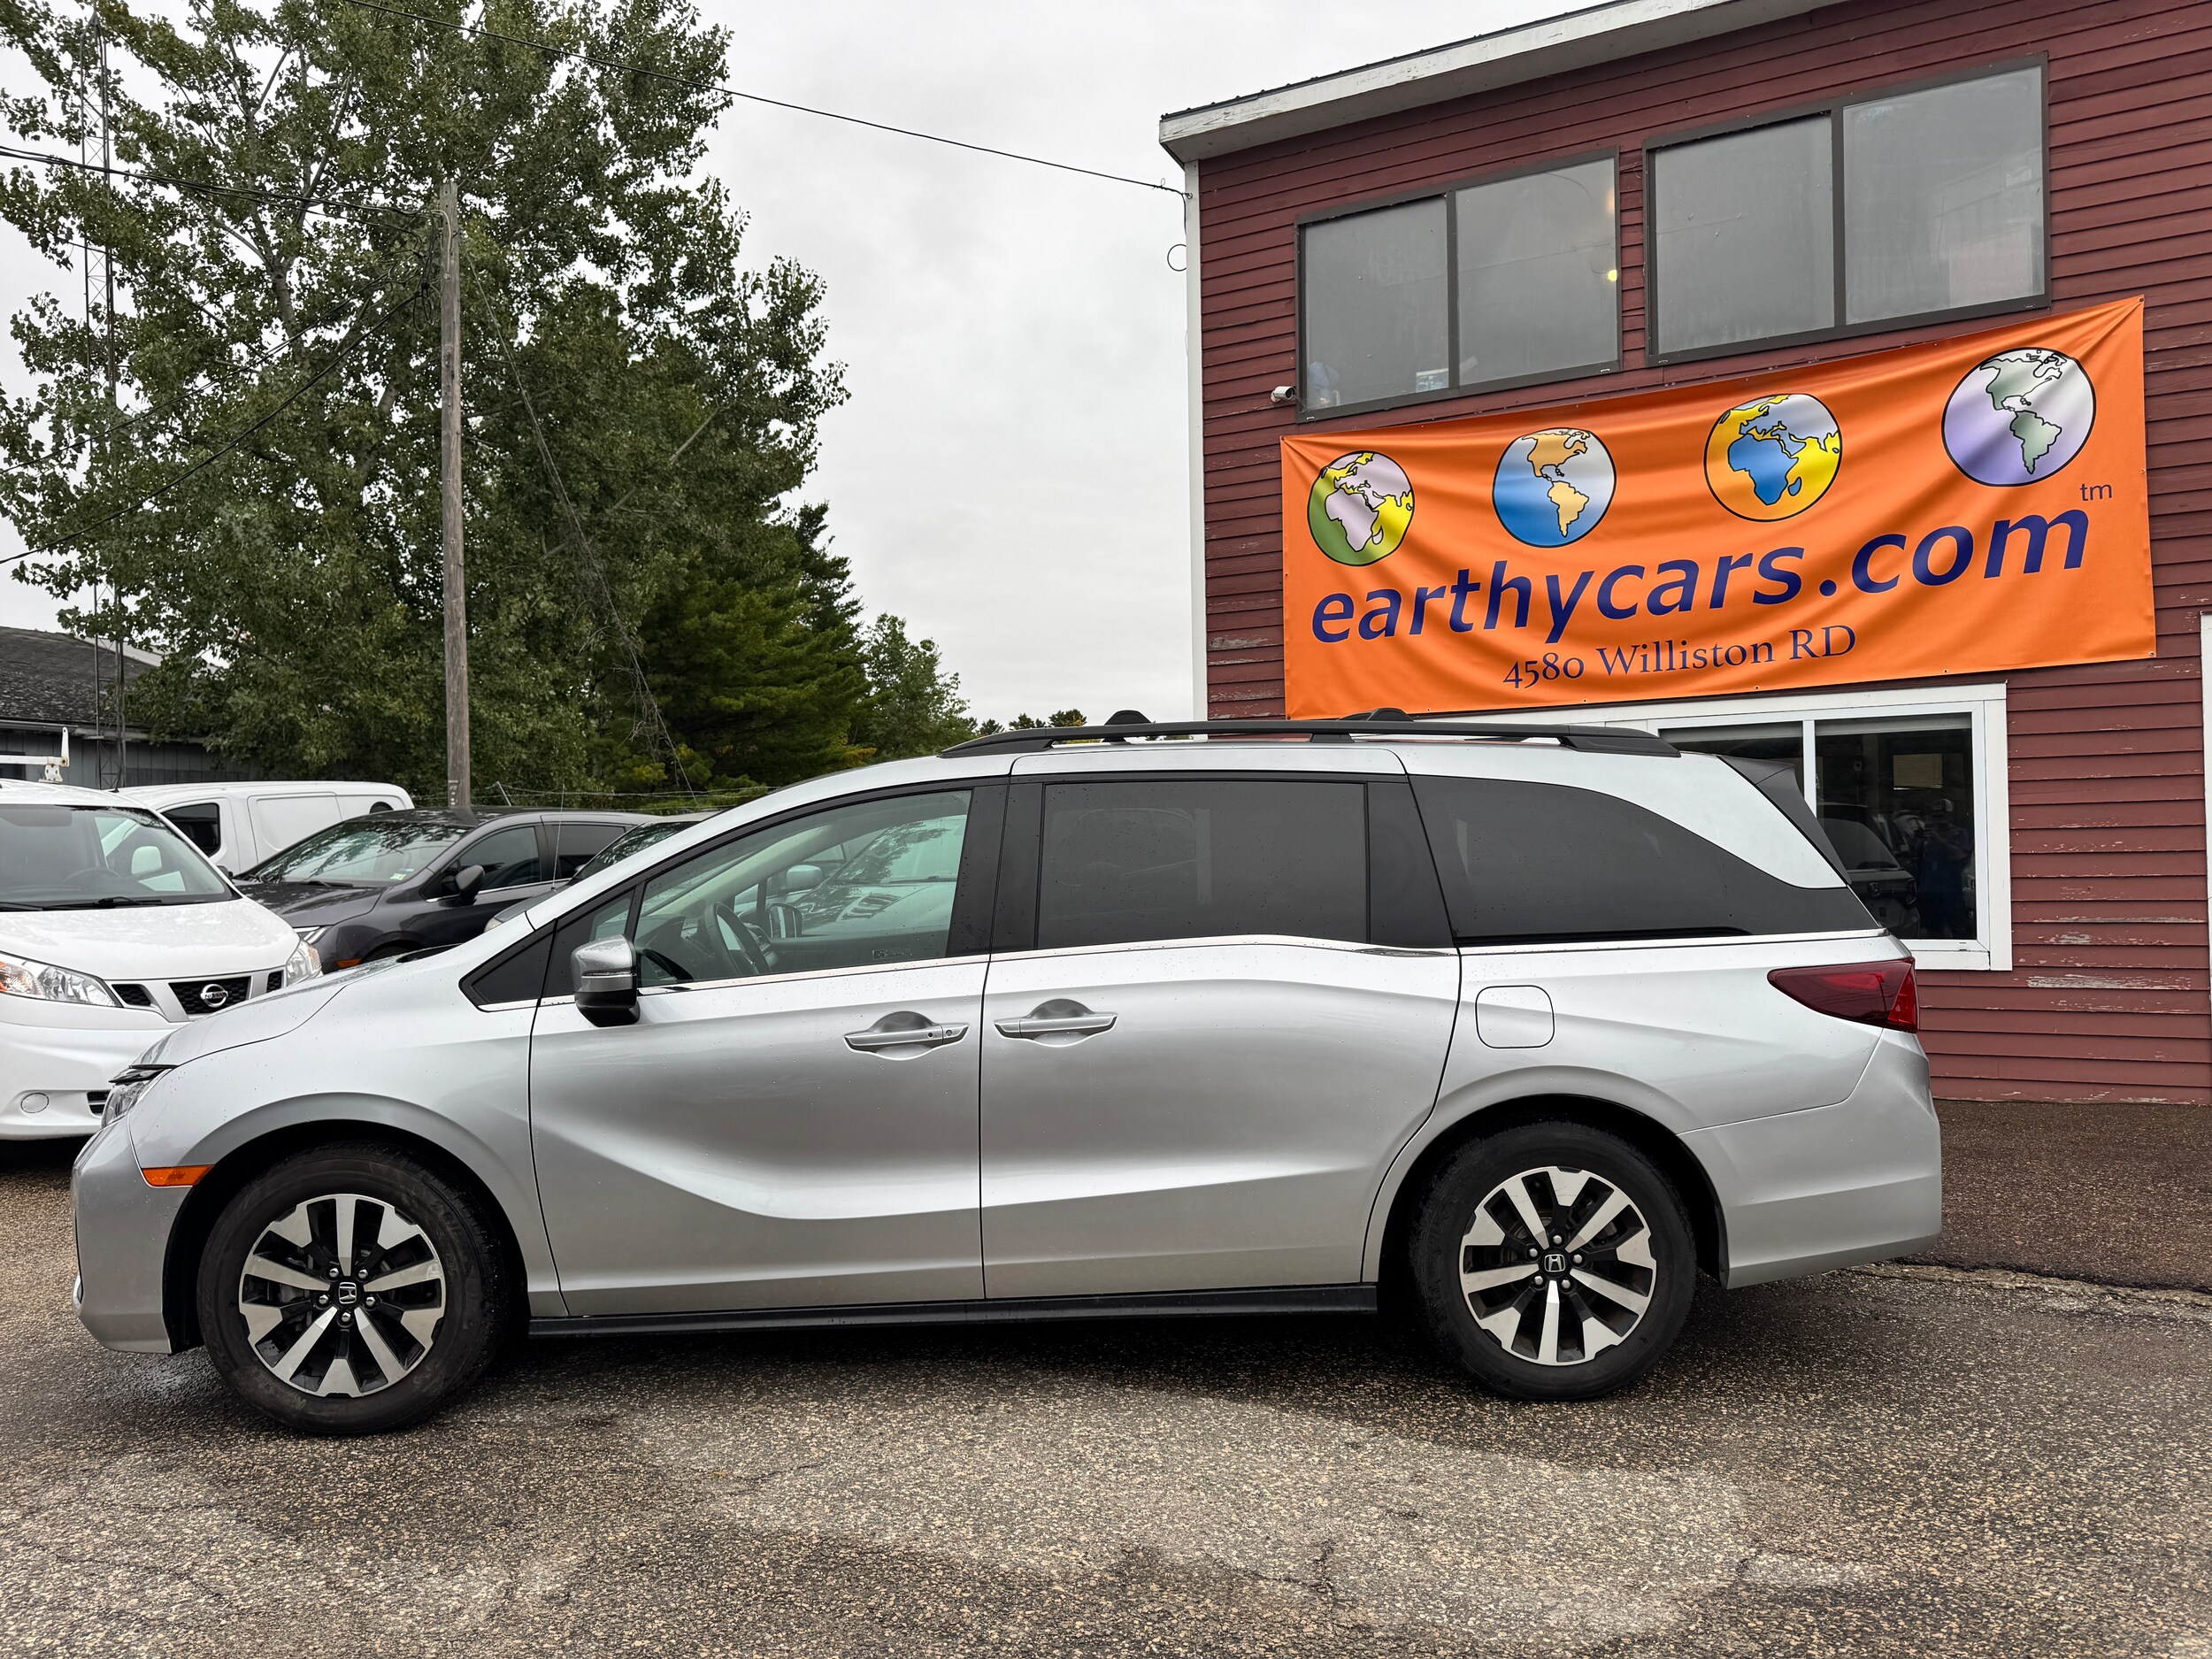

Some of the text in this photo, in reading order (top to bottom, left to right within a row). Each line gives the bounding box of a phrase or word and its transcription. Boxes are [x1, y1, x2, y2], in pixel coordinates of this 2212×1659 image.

[2079, 482, 2113, 502] tm
[1312, 508, 2089, 644] earthycars.com
[1502, 625, 1857, 689] 4580 Williston RD
